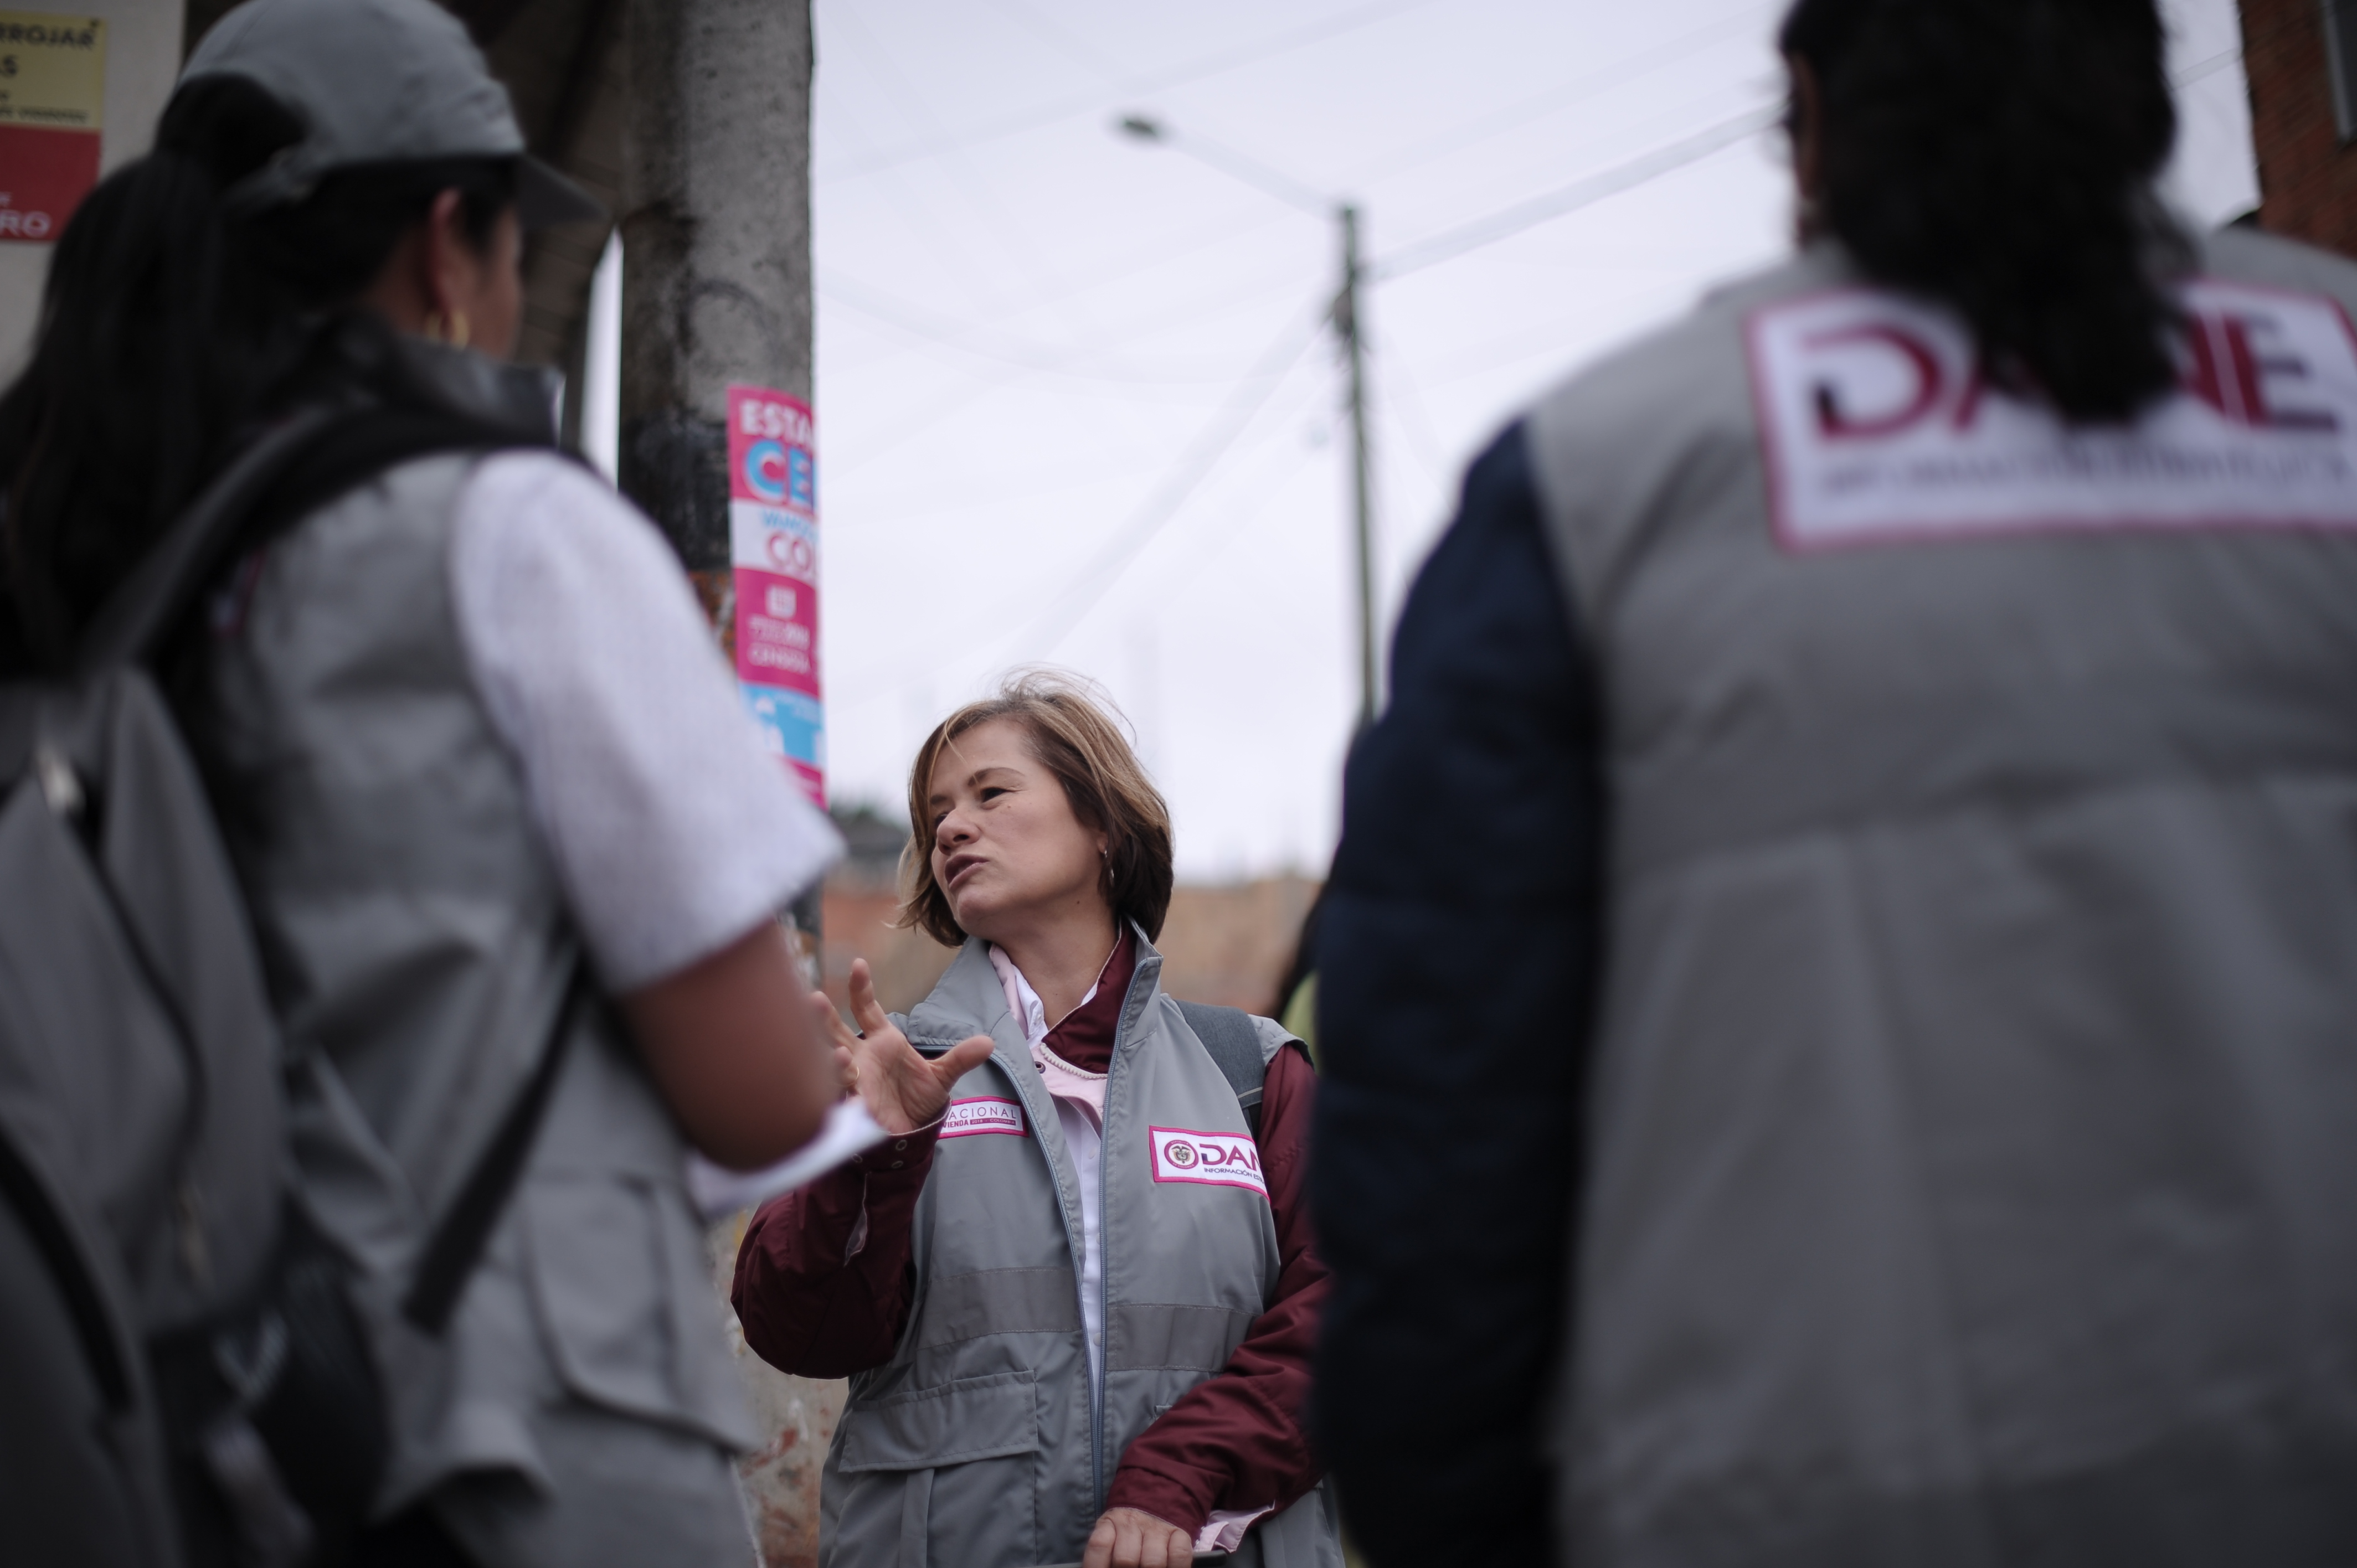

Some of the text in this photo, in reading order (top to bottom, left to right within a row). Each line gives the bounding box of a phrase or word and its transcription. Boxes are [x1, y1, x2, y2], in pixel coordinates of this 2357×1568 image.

[766, 530, 817, 579] CO
[948, 1106, 1017, 1121] ACIONAL
[1204, 1167, 1253, 1178] INFORMACIÓN
